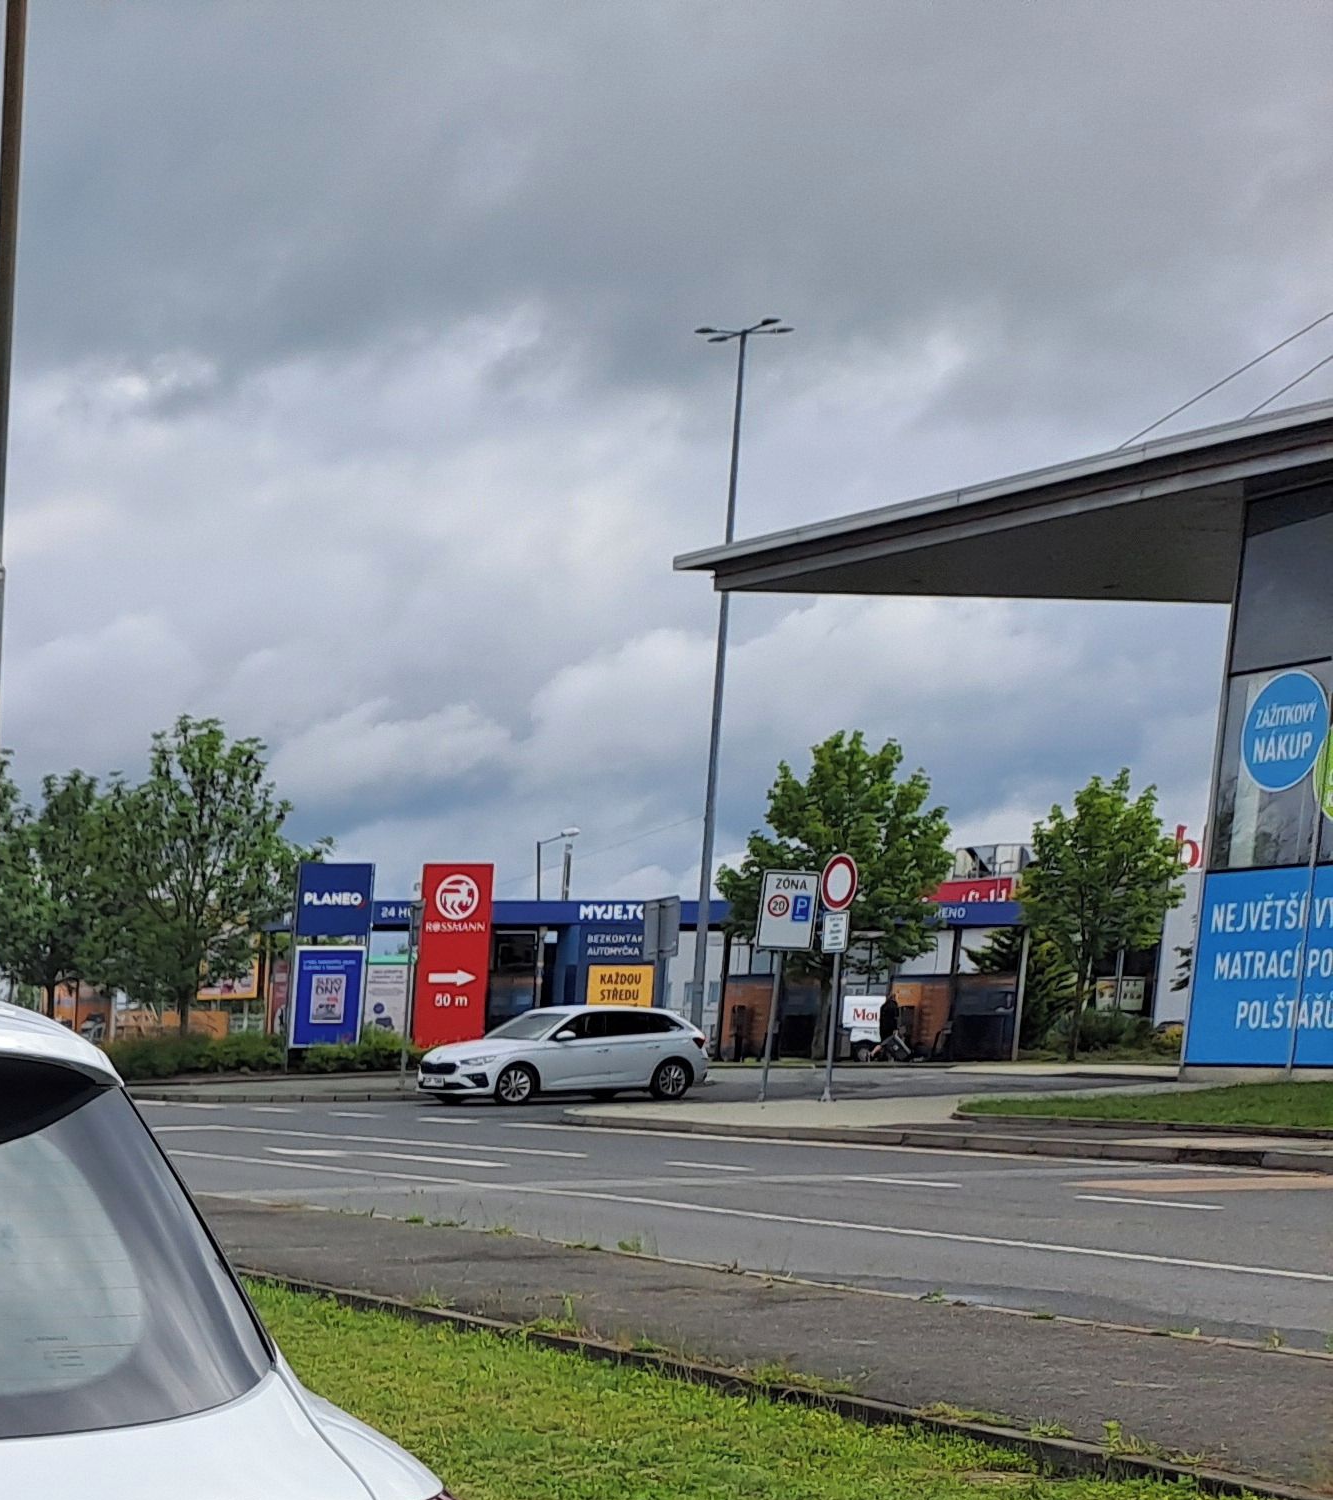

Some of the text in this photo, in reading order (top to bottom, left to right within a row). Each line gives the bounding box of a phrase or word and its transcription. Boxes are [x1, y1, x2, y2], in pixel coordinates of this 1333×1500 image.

[1252, 729, 1313, 764] NÁKUP
[775, 877, 808, 890] ZÓNA
[304, 892, 363, 906] PLANEO
[772, 900, 785, 912] 20
[1211, 891, 1308, 933] NEJVĚTŠÍ
[426, 922, 485, 932] ROSSMANN
[587, 944, 640, 956] AUTOMYČKA
[1214, 942, 1302, 980] MATRACÍ
[600, 972, 641, 985] KAŽDOU
[454, 995, 468, 1007] m
[600, 988, 639, 1001] STŘEDU
